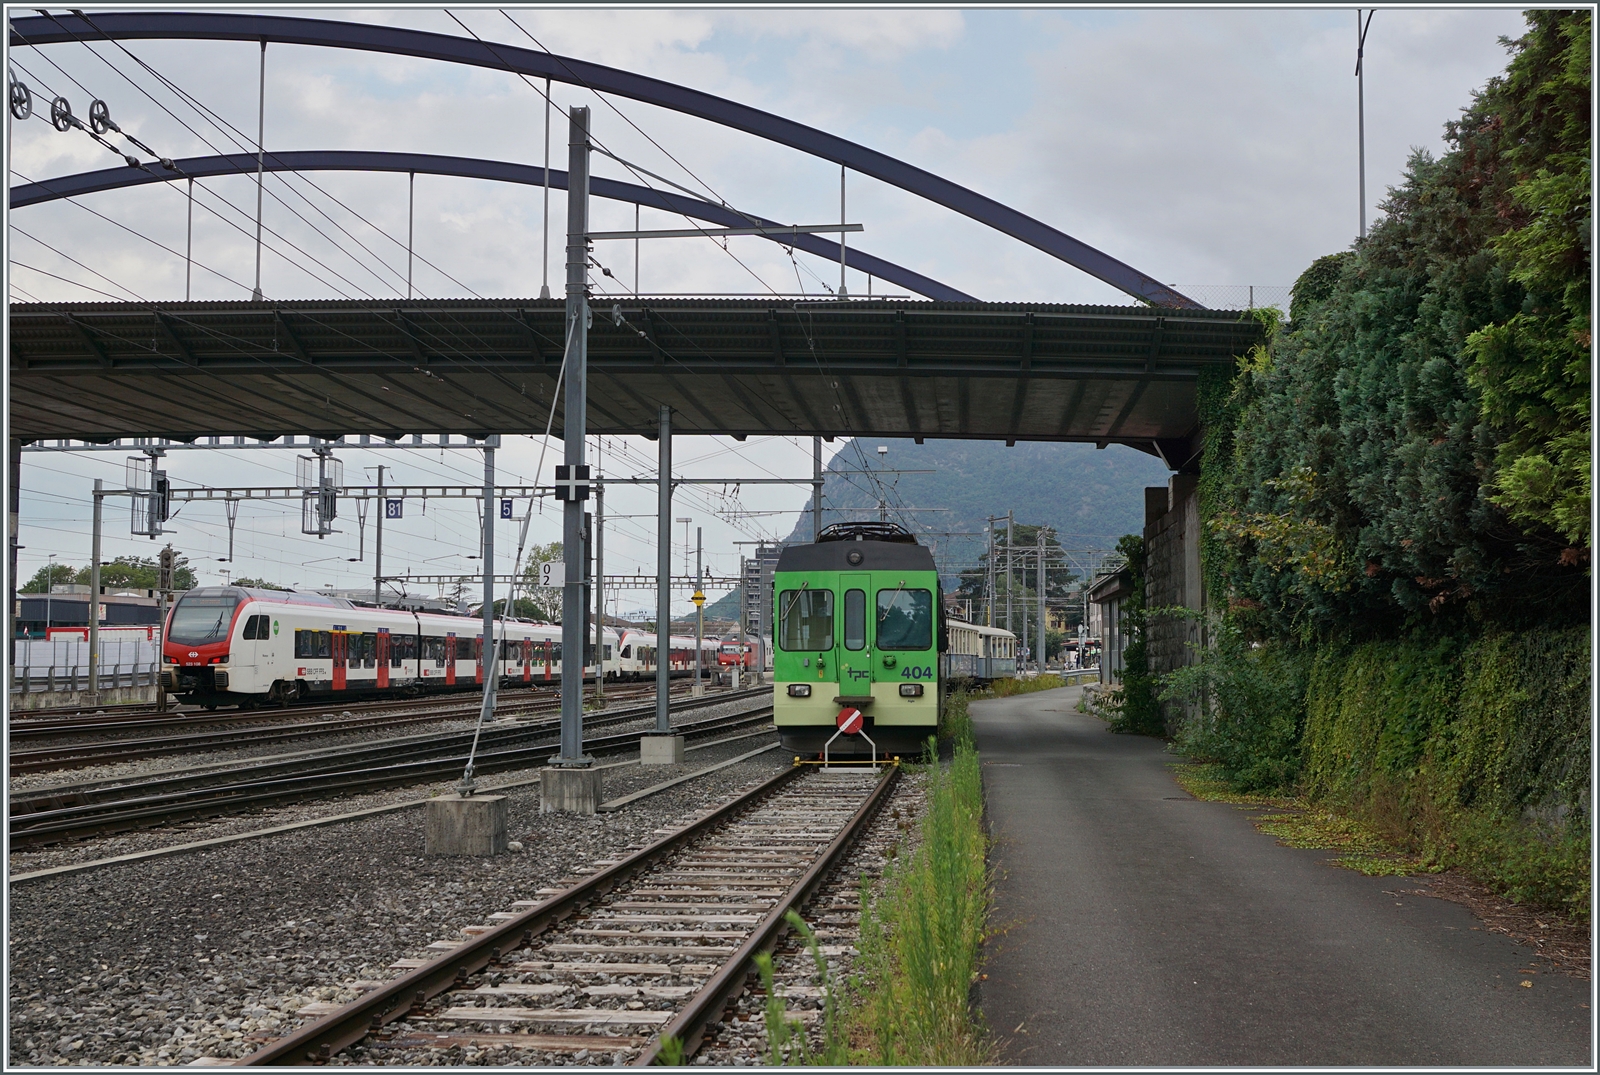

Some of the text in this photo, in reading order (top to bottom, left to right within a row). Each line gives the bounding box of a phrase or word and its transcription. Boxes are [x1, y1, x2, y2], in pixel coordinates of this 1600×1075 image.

[388, 503, 401, 516] 81
[503, 503, 510, 516] 5
[543, 576, 550, 586] 2
[847, 667, 869, 681] tpc
[901, 666, 932, 679] 404
